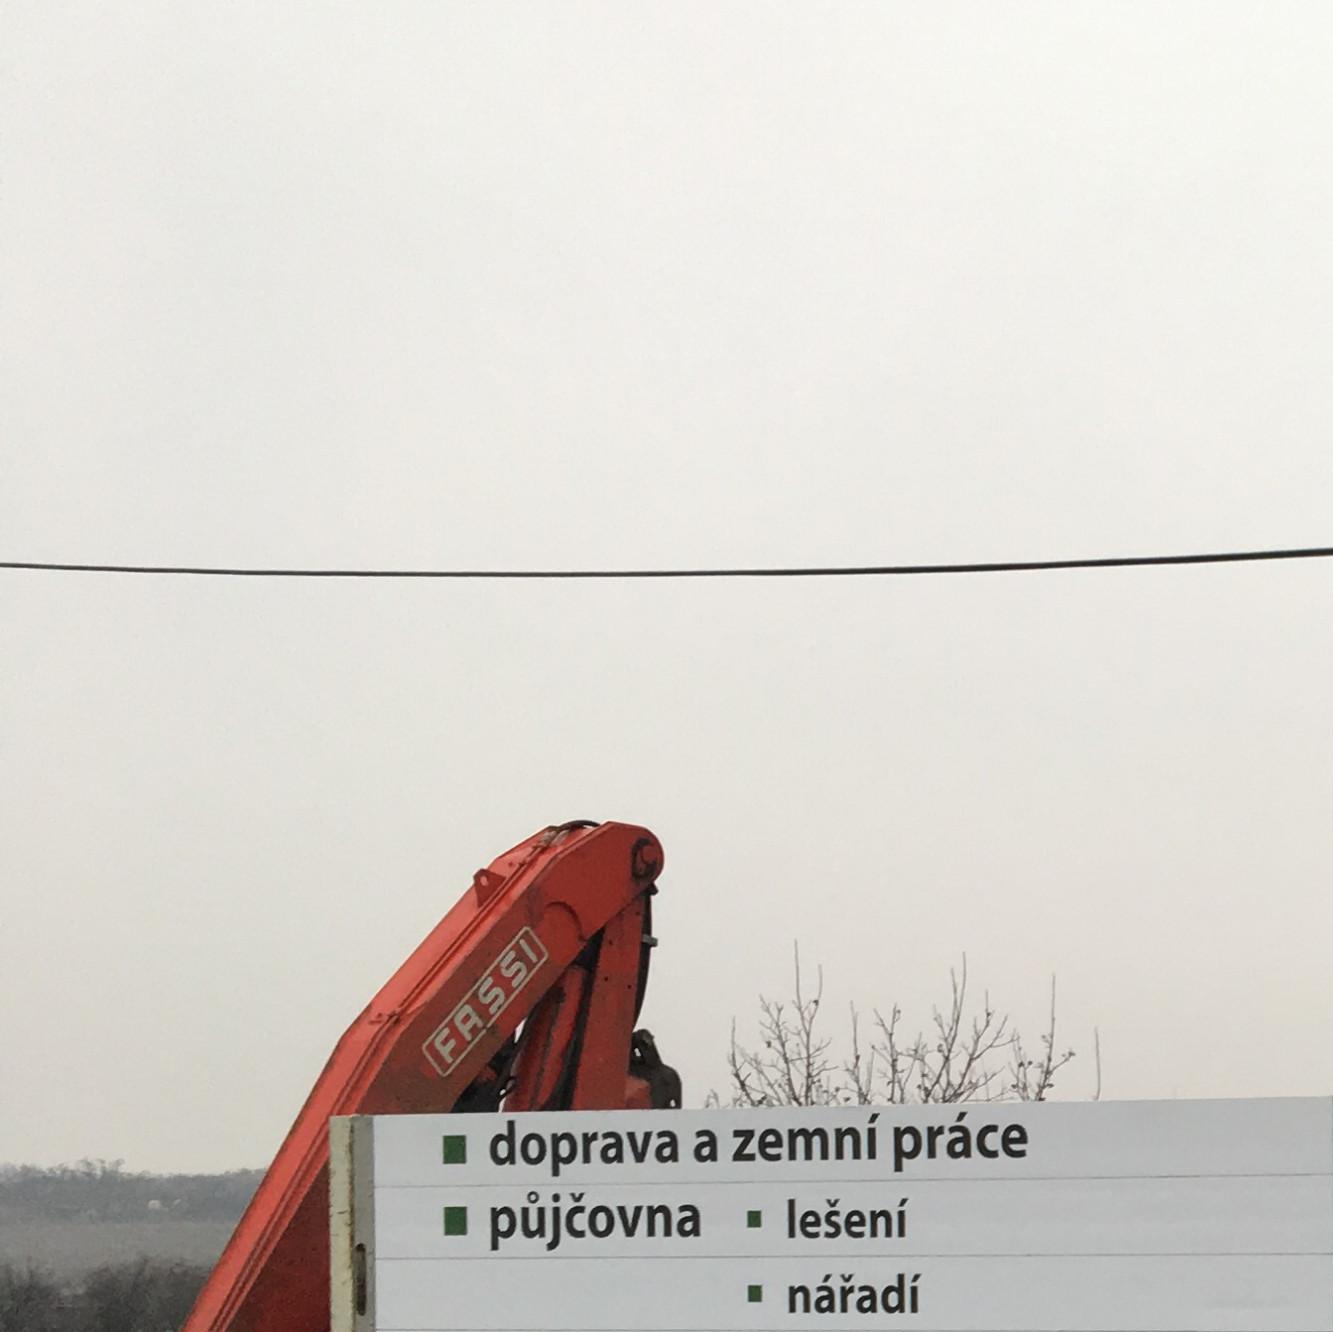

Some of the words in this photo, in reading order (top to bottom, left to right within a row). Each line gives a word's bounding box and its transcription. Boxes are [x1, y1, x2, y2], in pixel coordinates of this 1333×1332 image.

[433, 938, 538, 1063] FASSI
[490, 1114, 679, 1176] doprava
[694, 1130, 717, 1162] a
[733, 1113, 880, 1161] zemní
[894, 1112, 1028, 1169] práce
[491, 1191, 700, 1251] půjčovna
[788, 1198, 908, 1238] lešení
[789, 1274, 920, 1313] nářadí
